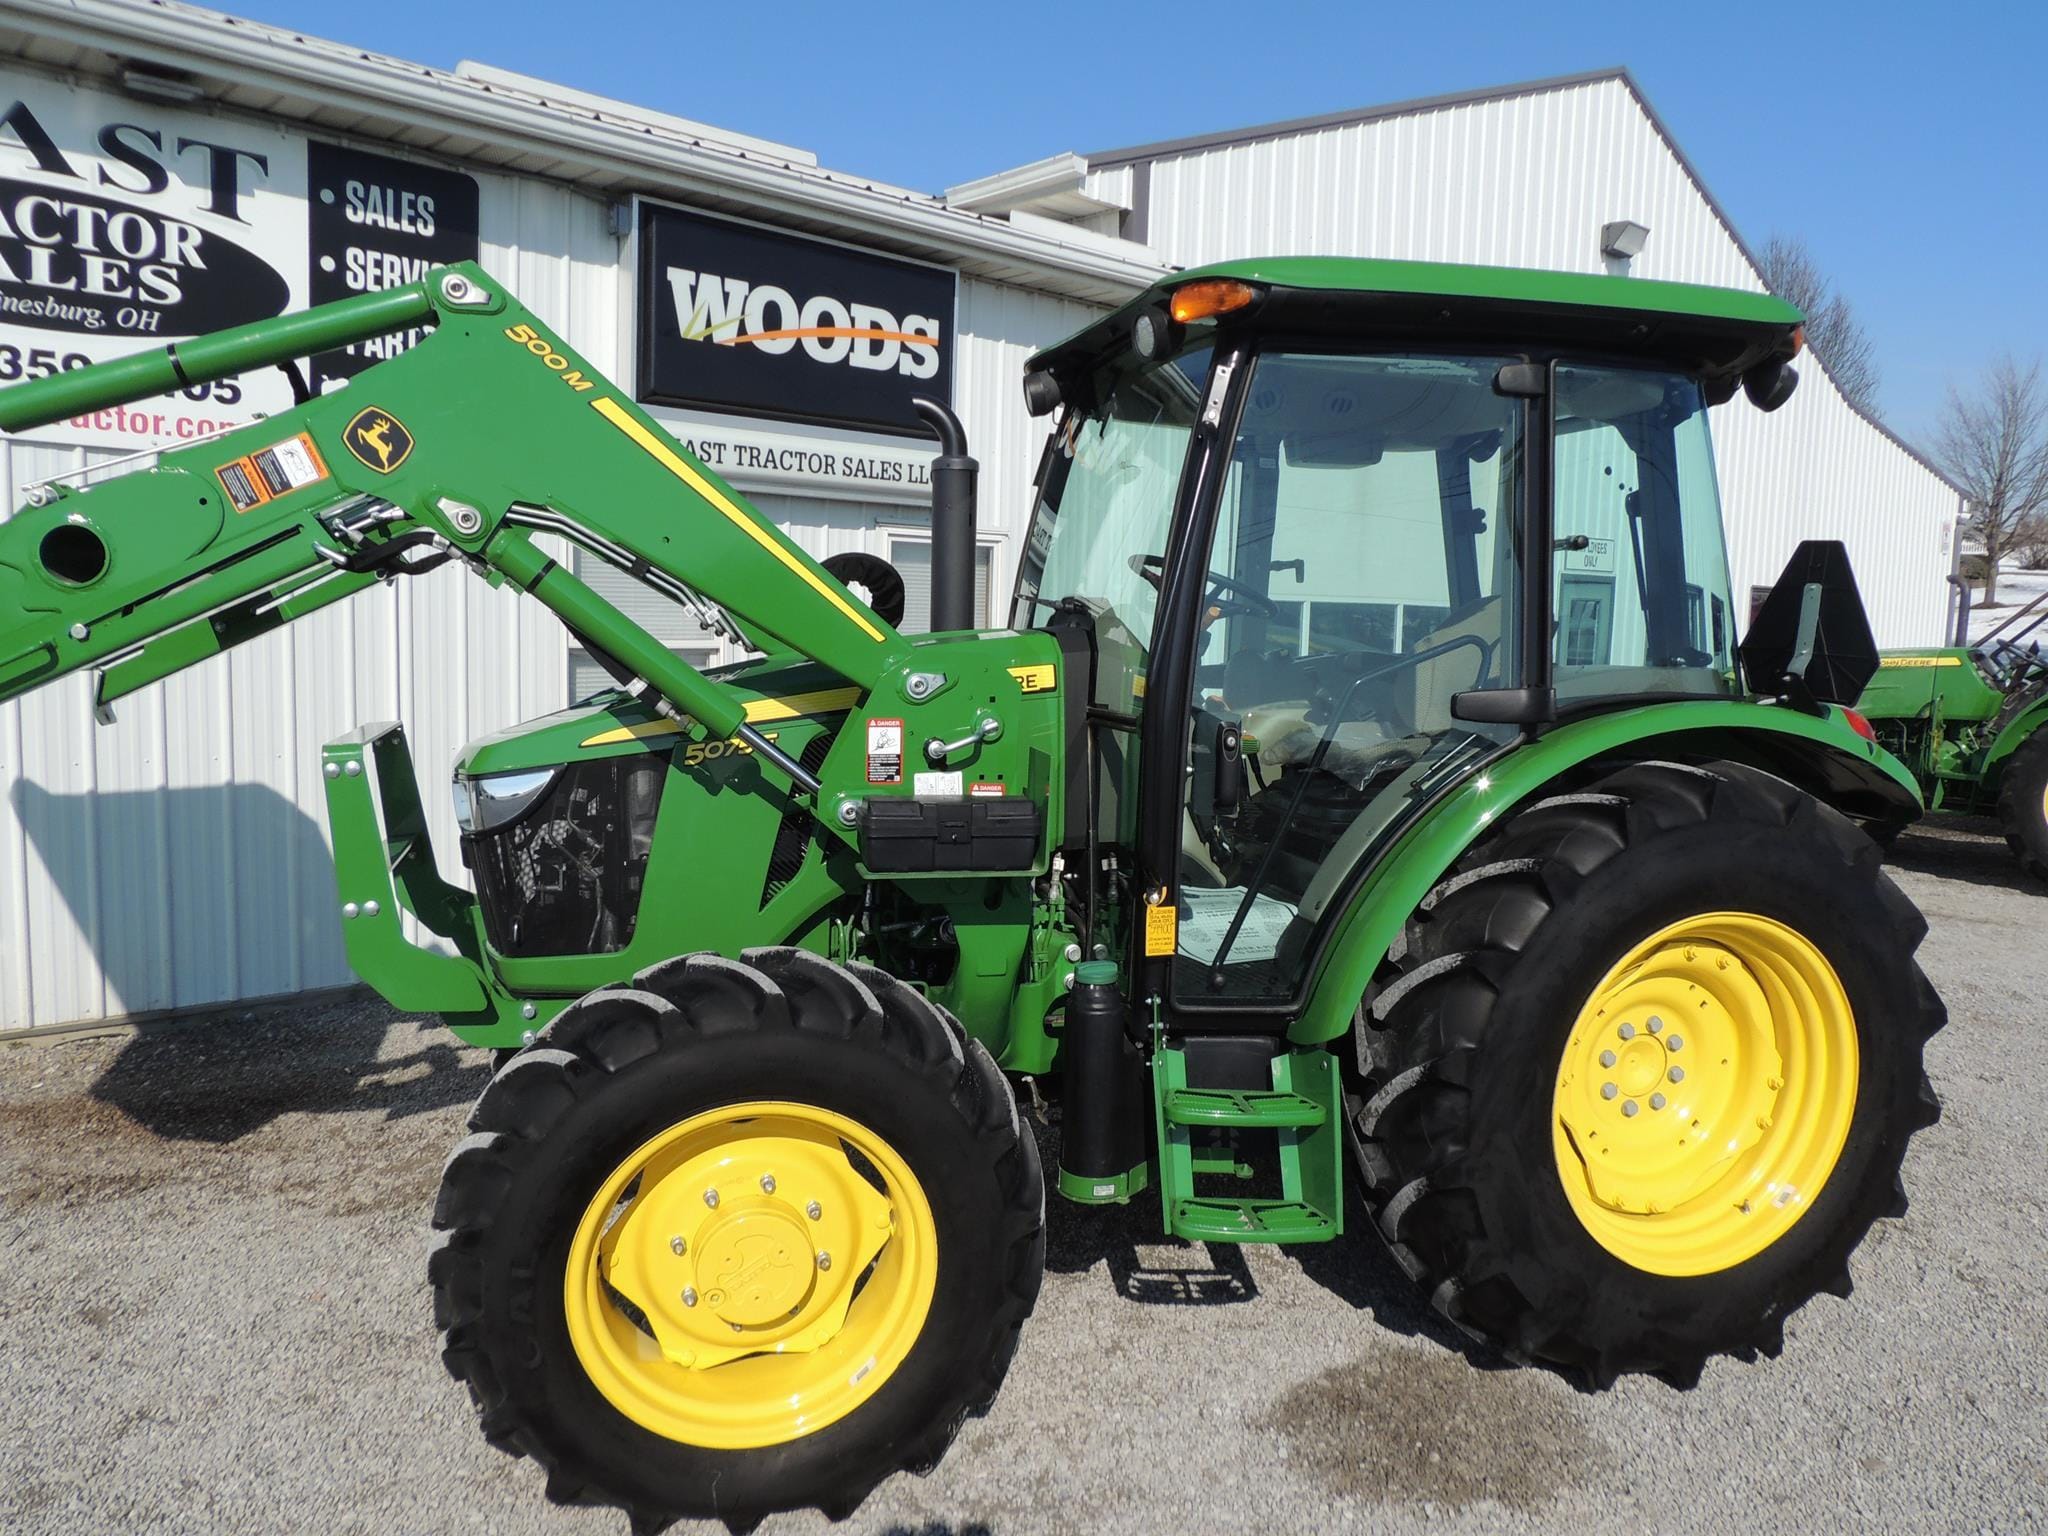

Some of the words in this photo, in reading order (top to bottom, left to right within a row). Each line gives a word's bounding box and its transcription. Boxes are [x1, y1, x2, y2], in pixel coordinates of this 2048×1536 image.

[346, 180, 435, 238] SALES
[346, 247, 447, 292] SERVI
[0, 290, 107, 328] nesburg,
[116, 306, 162, 333] OH
[666, 266, 940, 380] WOODS
[682, 438, 727, 465] AST
[733, 444, 837, 477] TRACTOR
[842, 457, 903, 482] SALES
[907, 463, 934, 485] LL
